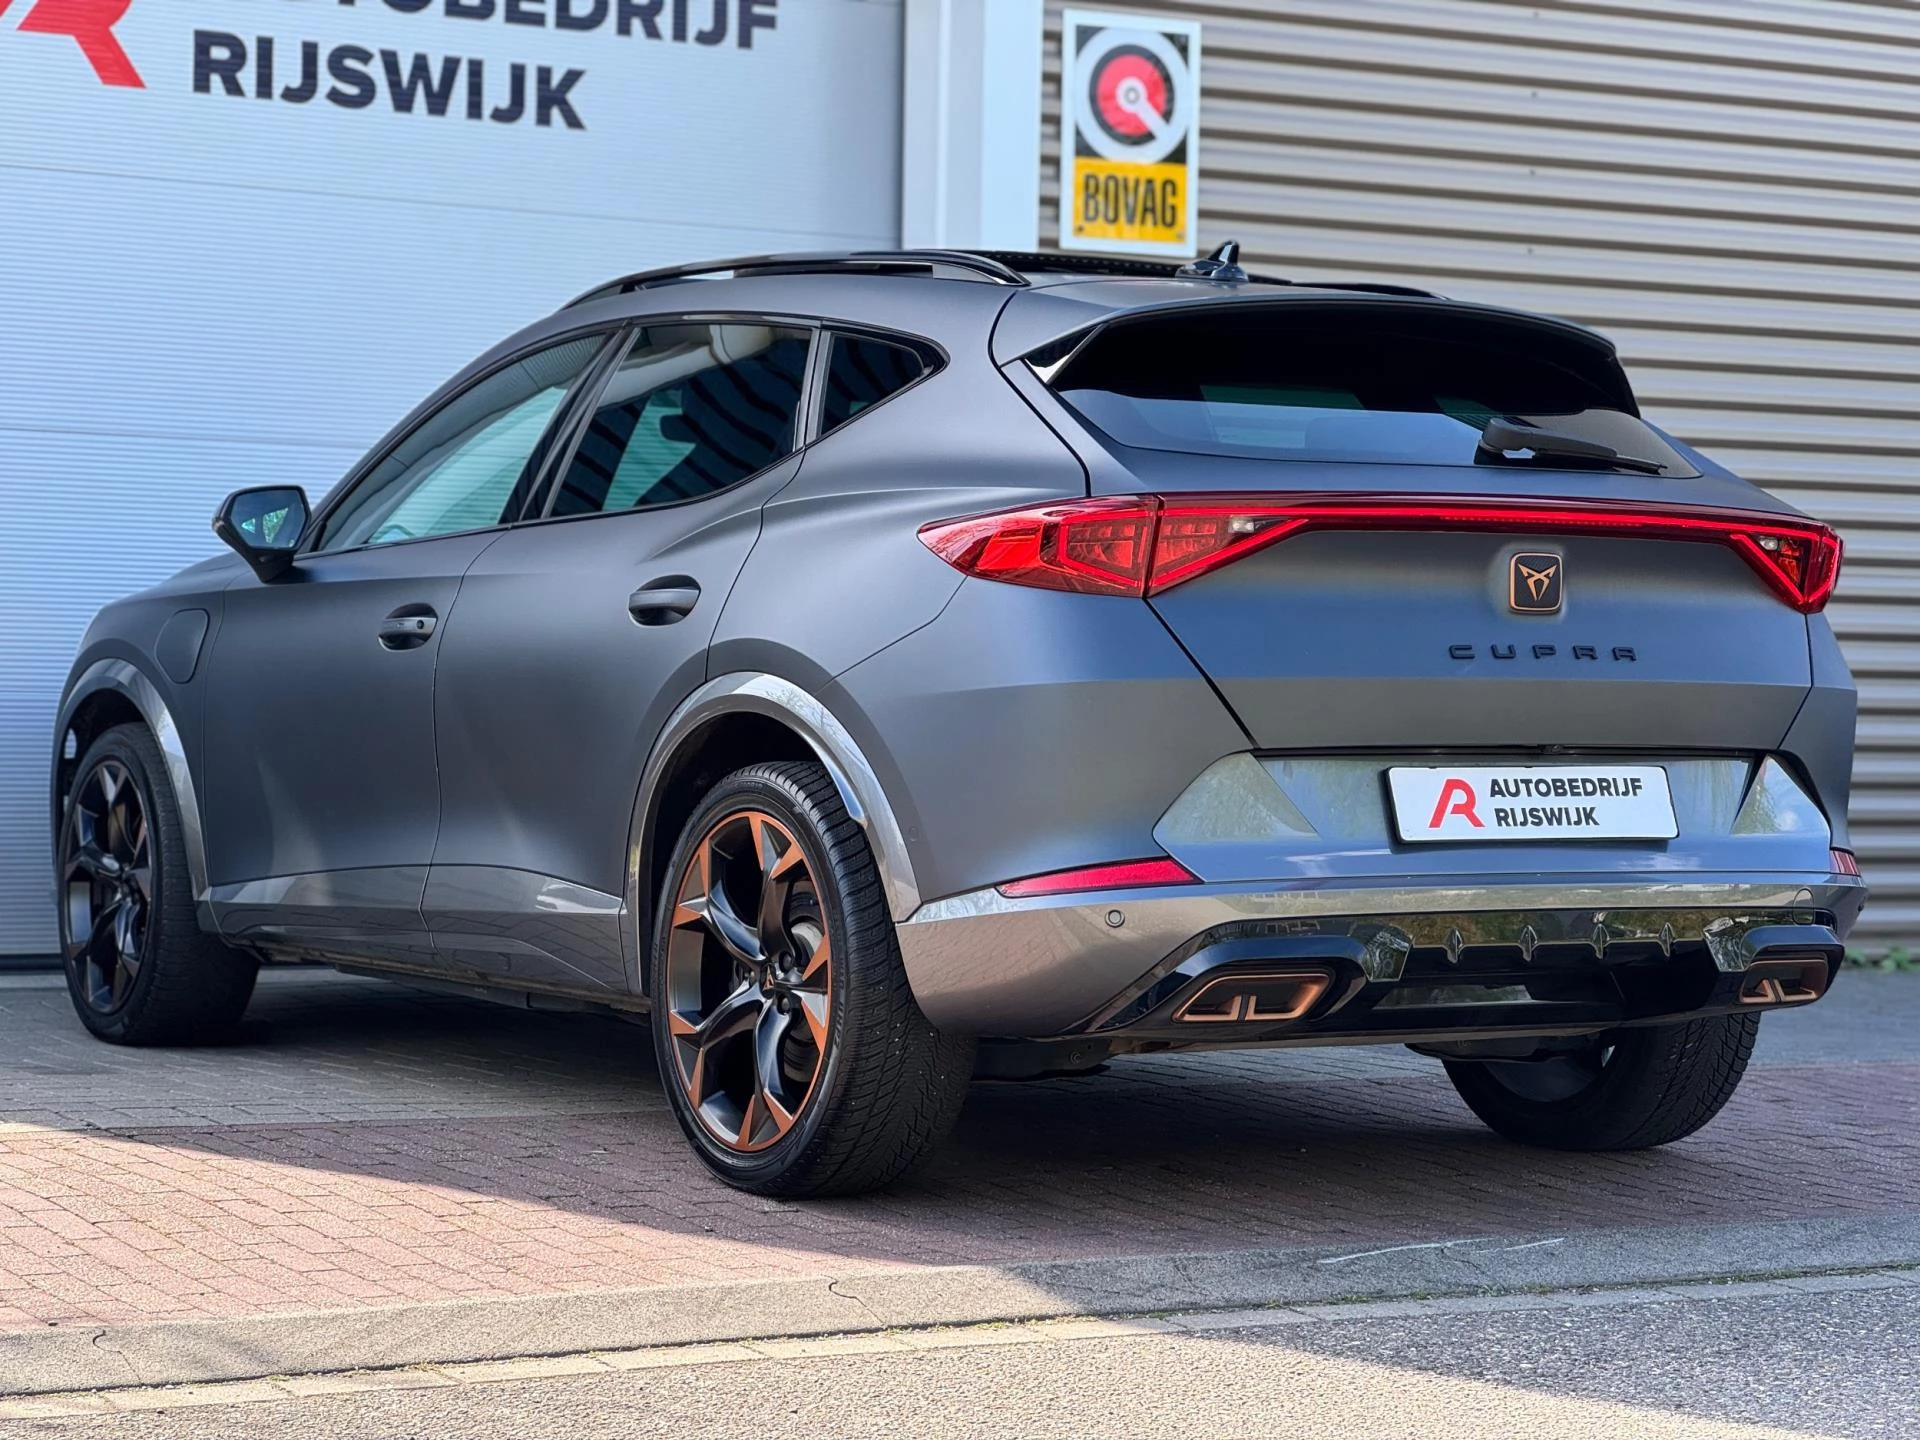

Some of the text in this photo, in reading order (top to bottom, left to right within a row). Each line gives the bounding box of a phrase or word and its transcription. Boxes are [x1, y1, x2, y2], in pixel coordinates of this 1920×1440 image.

[193, 29, 586, 130] RIJSWIJK
[1084, 173, 1177, 228] BOVAG
[1449, 644, 1638, 661] CUPRA
[1490, 777, 1643, 798] AUTOBEDRIJF
[1494, 807, 1600, 827] RIJSWIJK
